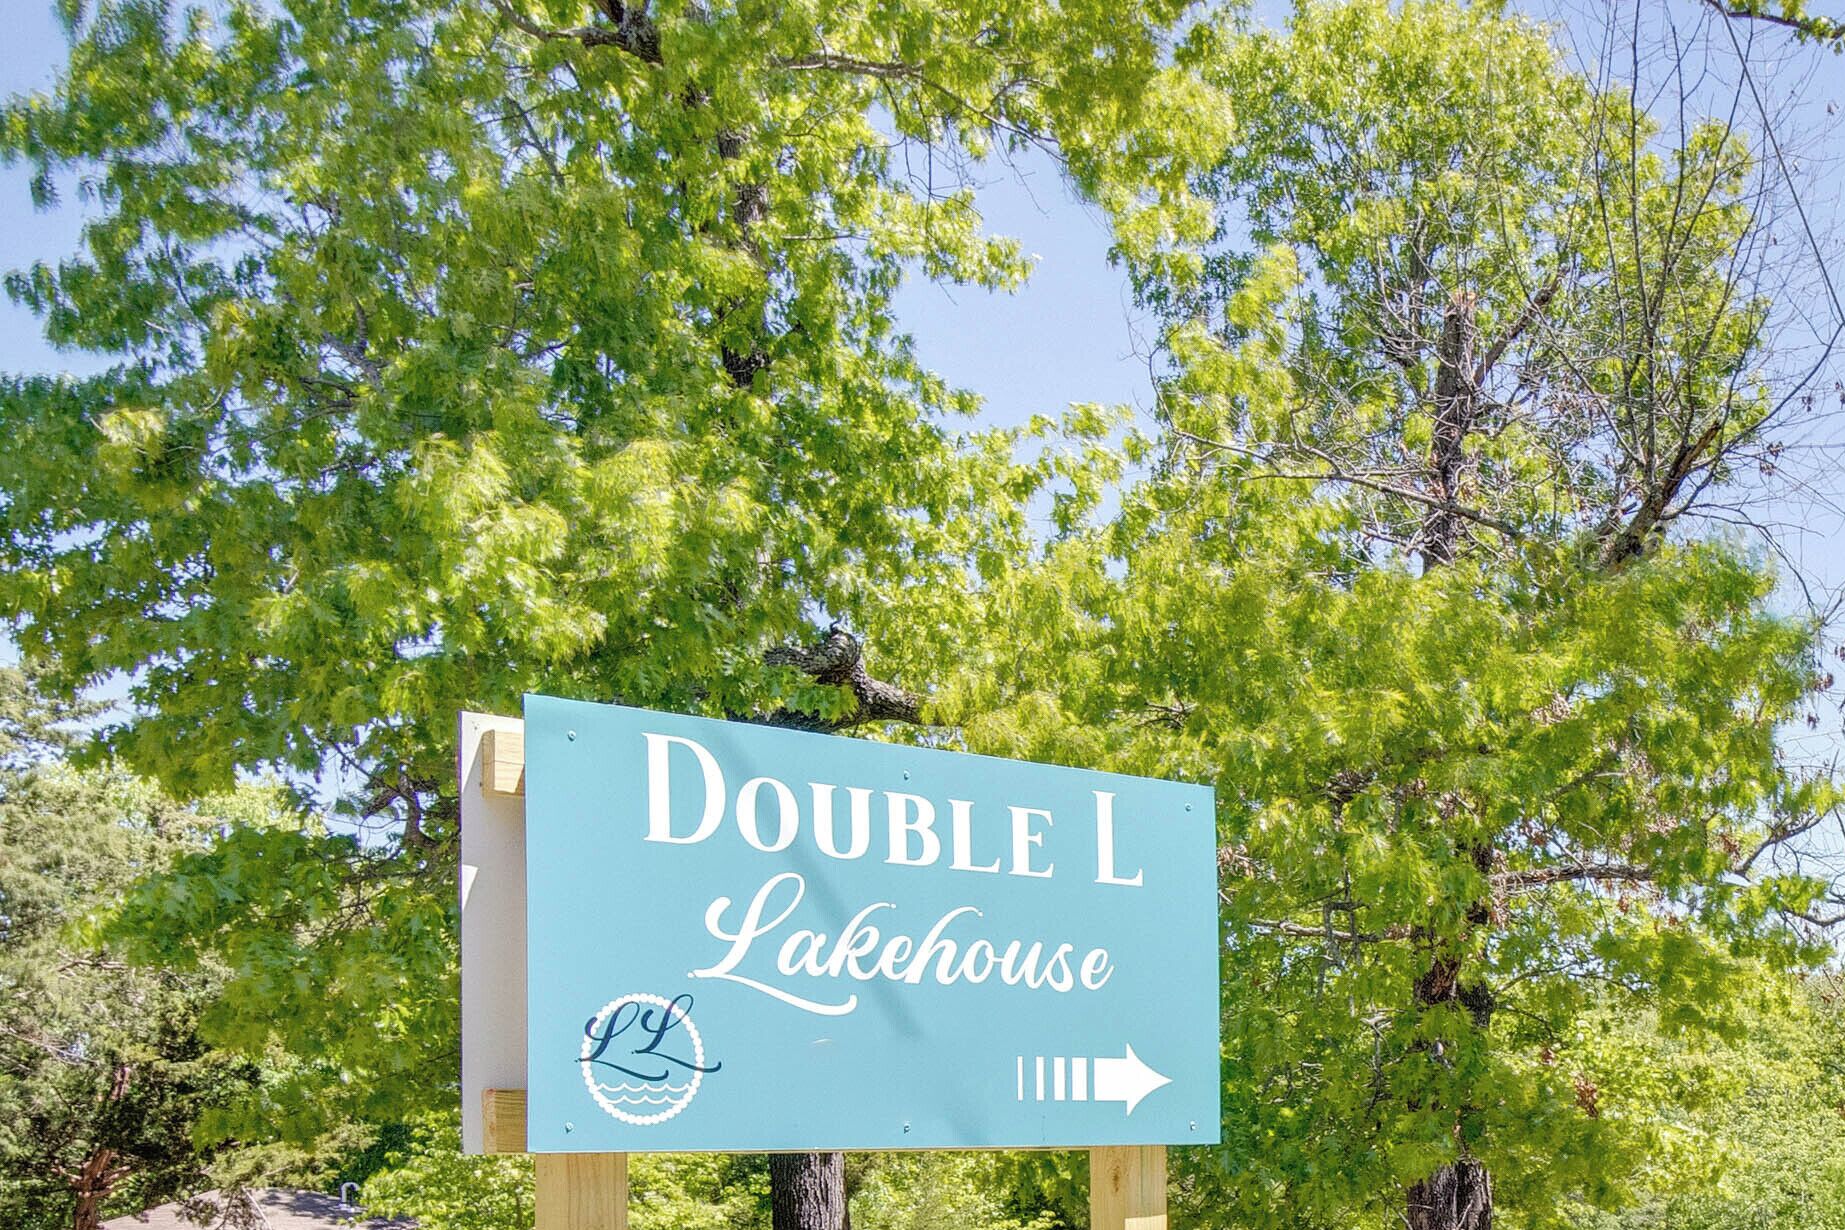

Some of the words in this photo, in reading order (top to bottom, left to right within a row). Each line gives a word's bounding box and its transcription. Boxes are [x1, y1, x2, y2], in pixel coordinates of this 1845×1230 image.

[642, 732, 1054, 878] DOUBLE
[1091, 790, 1144, 887] L
[687, 872, 1115, 1016] Lakehouse
